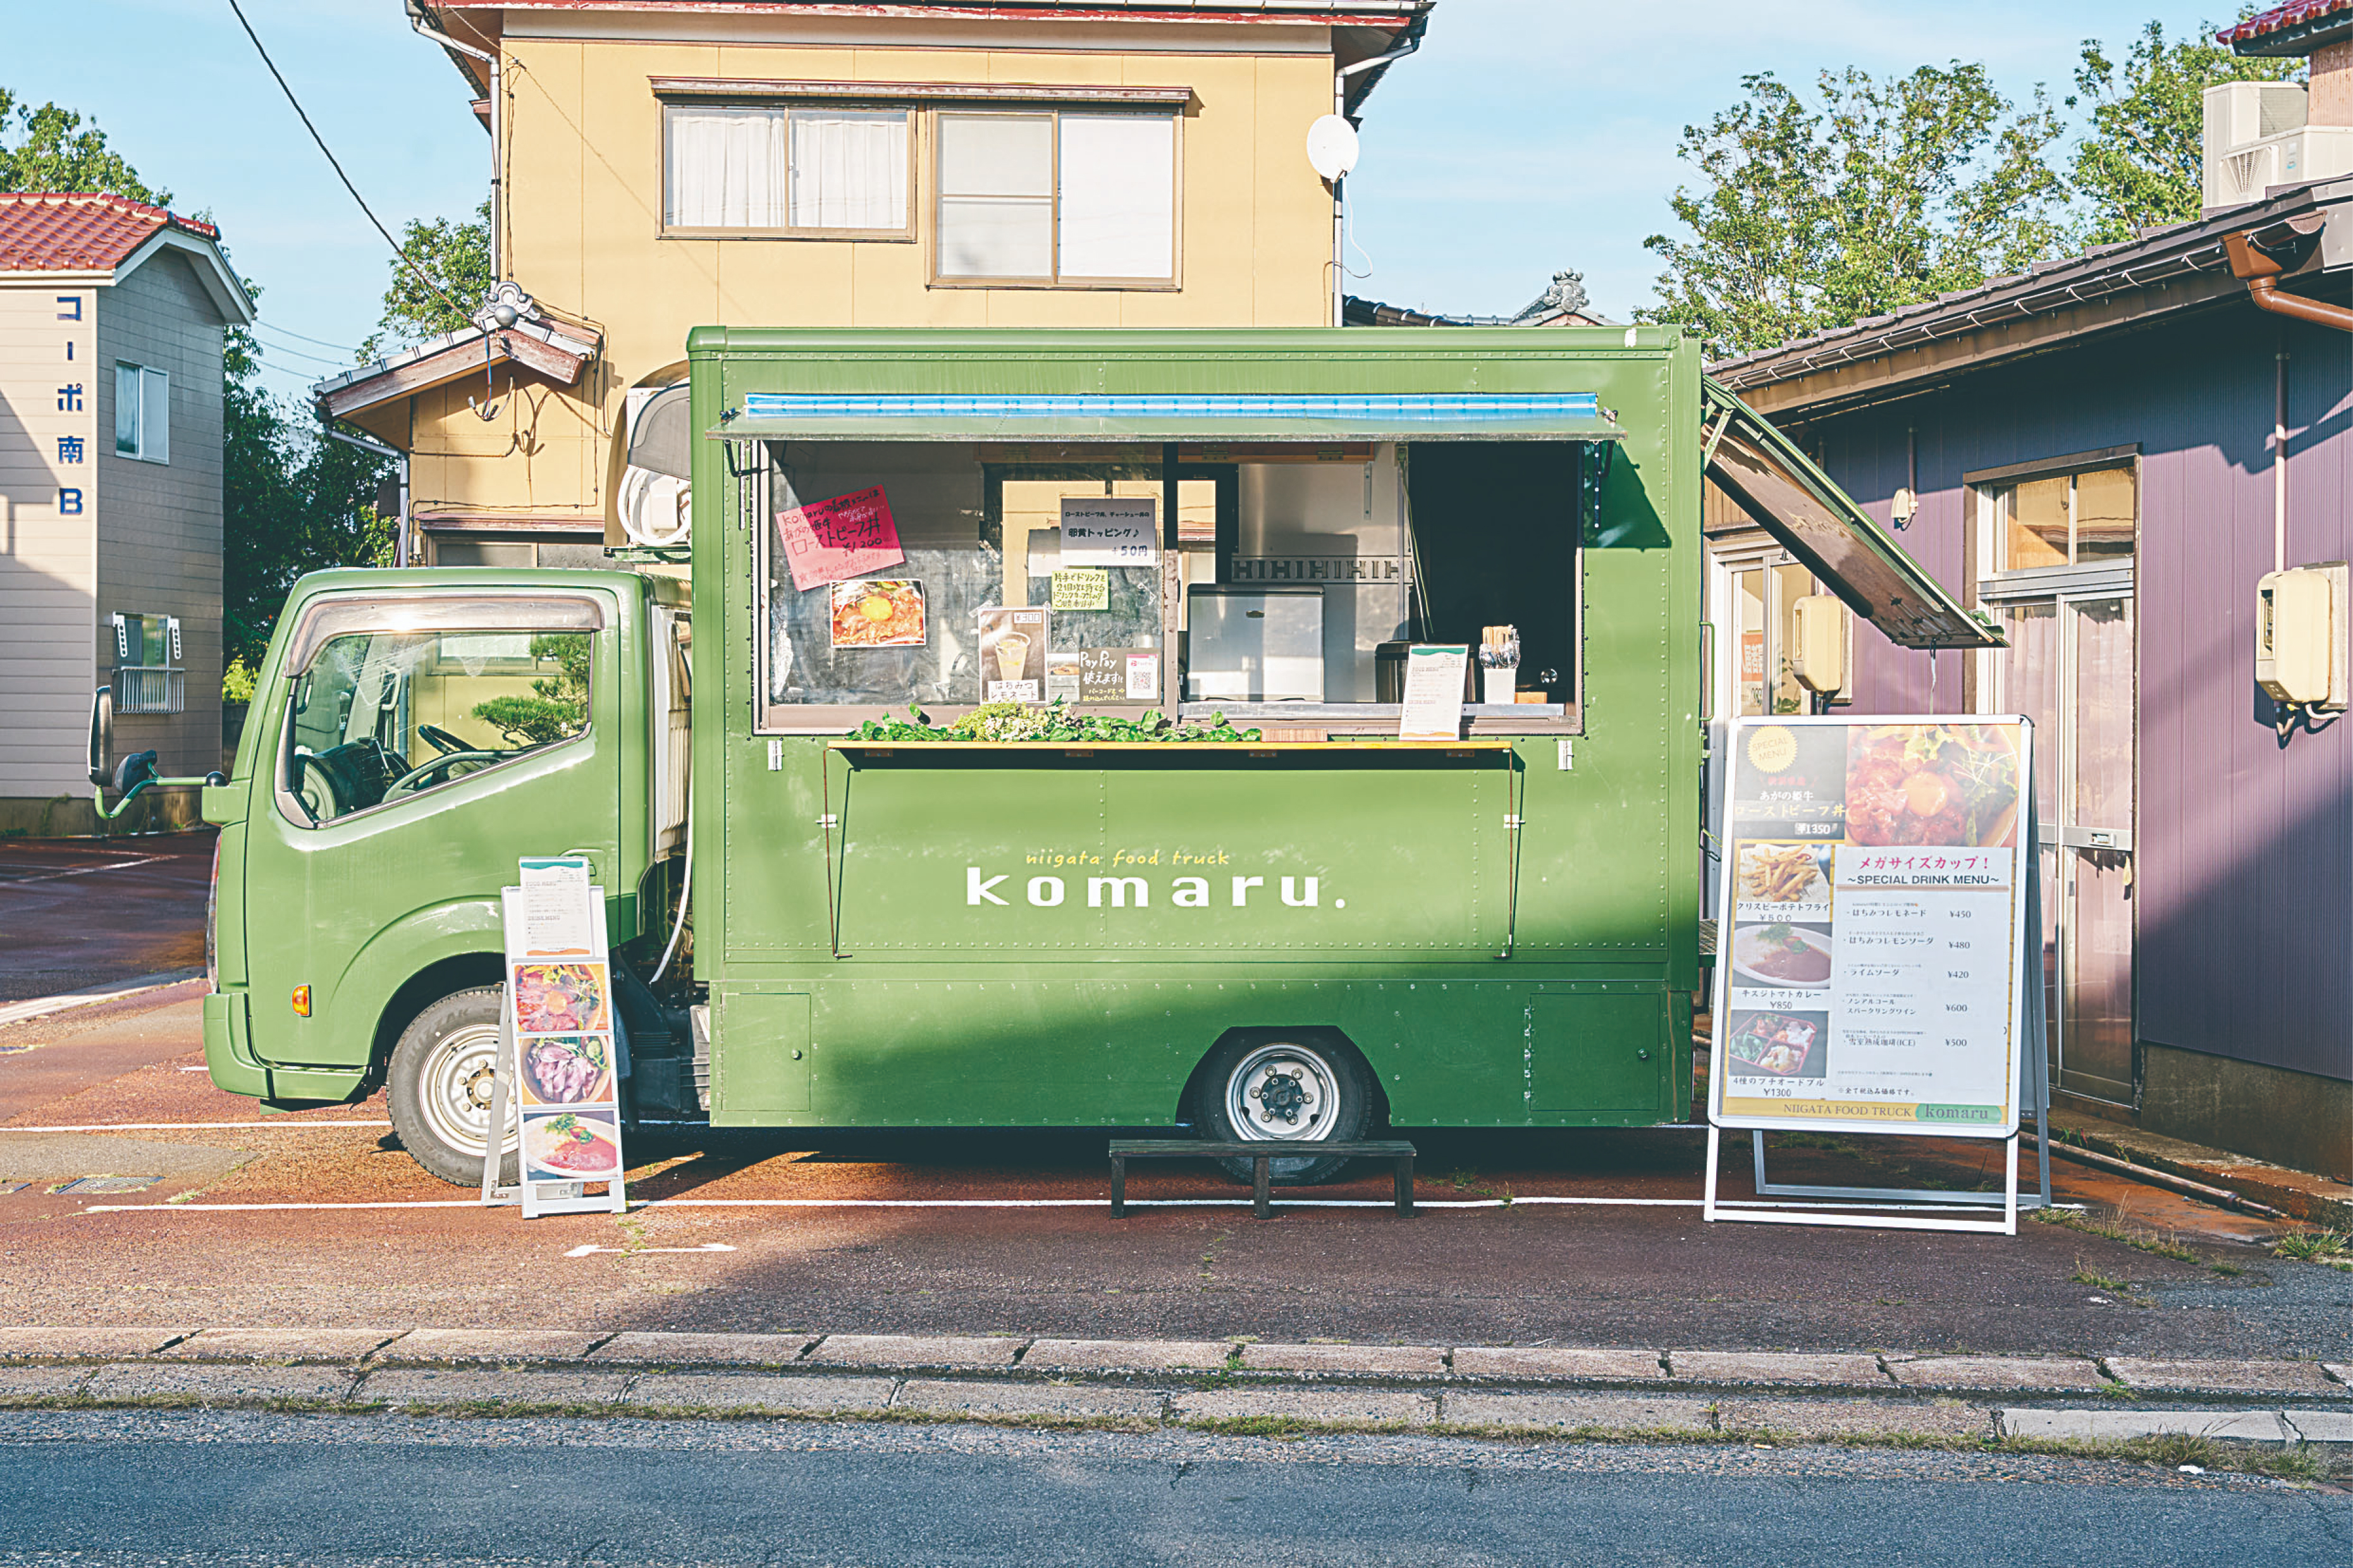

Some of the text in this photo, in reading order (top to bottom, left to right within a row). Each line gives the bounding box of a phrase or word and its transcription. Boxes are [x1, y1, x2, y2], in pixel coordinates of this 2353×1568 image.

[56, 296, 85, 516] コーポ南B
[1752, 737, 1789, 752] SPECIAL
[1758, 747, 1787, 761] MENU
[1735, 803, 1846, 818] ローストビーフ丼
[1025, 848, 1230, 868] niigata food truck
[1912, 874, 1950, 885] DRINK
[1737, 902, 1829, 911] クリスピーポテトフライ
[1949, 910, 1972, 918] ¥450
[1948, 941, 1970, 949] ¥480
[1947, 971, 1969, 979] ¥420
[1770, 1001, 1793, 1010] ¥850
[1763, 1088, 1792, 1097] ¥1300
[1784, 1103, 1989, 1119] NIIGATA FOOD TRUCK komaru
